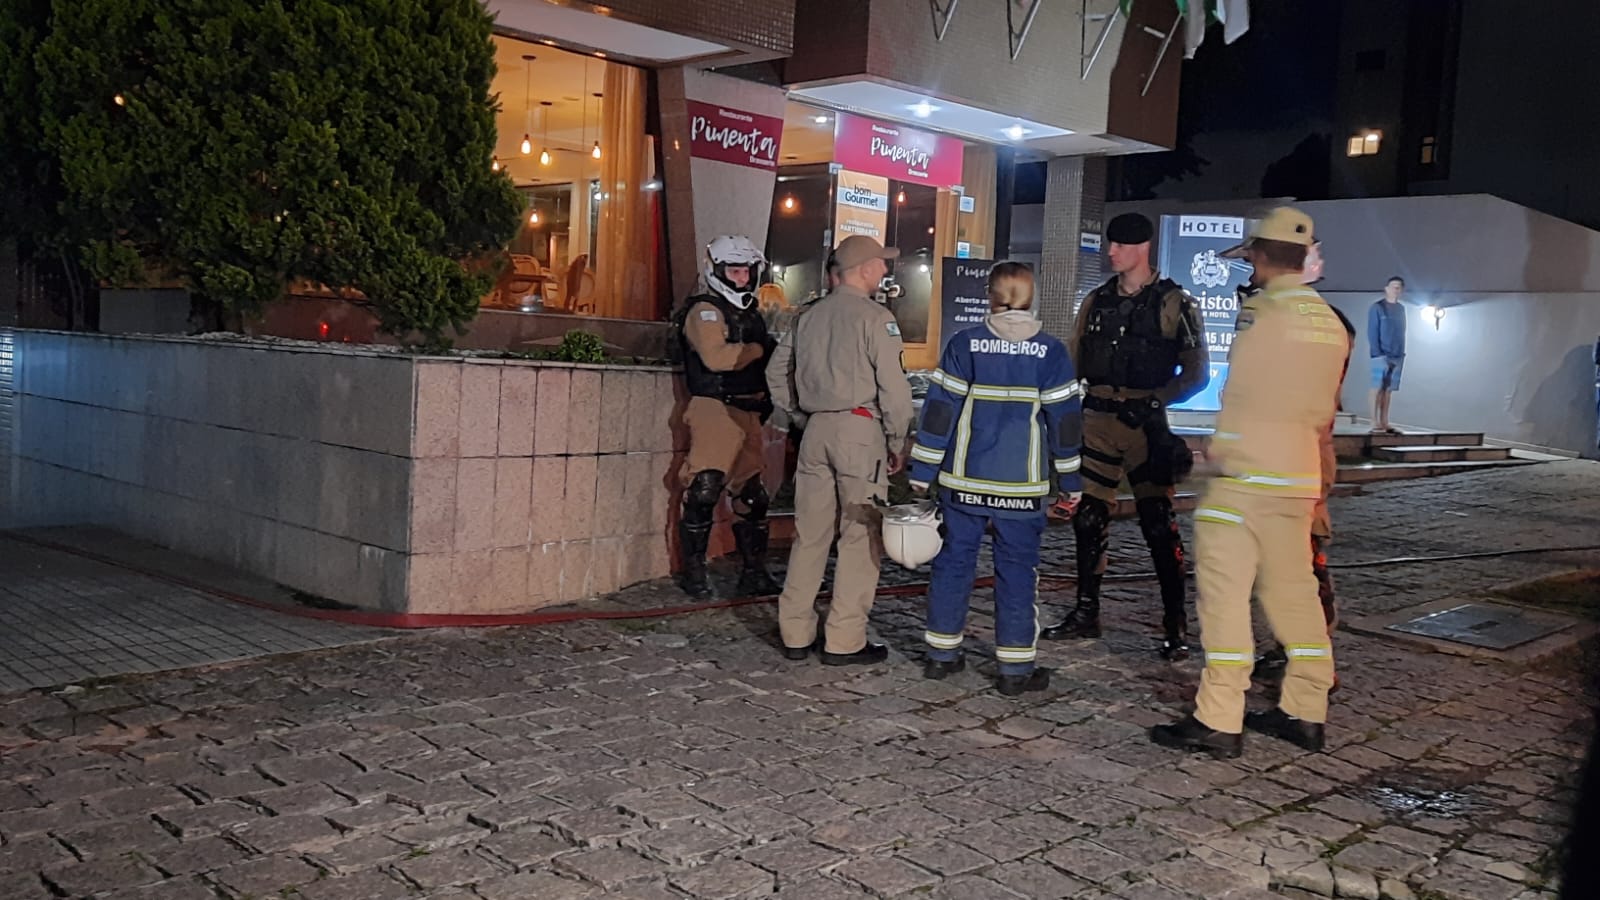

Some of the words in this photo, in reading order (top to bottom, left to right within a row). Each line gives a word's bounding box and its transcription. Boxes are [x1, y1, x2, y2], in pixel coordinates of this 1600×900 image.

[691, 115, 777, 160] Pimenta
[871, 136, 929, 170] Pimenta
[845, 191, 879, 207] Gourmet
[854, 184, 872, 197] bom
[1182, 221, 1241, 235] HOTEL
[1209, 311, 1231, 319] HOTEL
[970, 339, 1048, 358] BOMBEIROS
[957, 492, 985, 505] TEN.
[987, 496, 1034, 510] LIANNA
